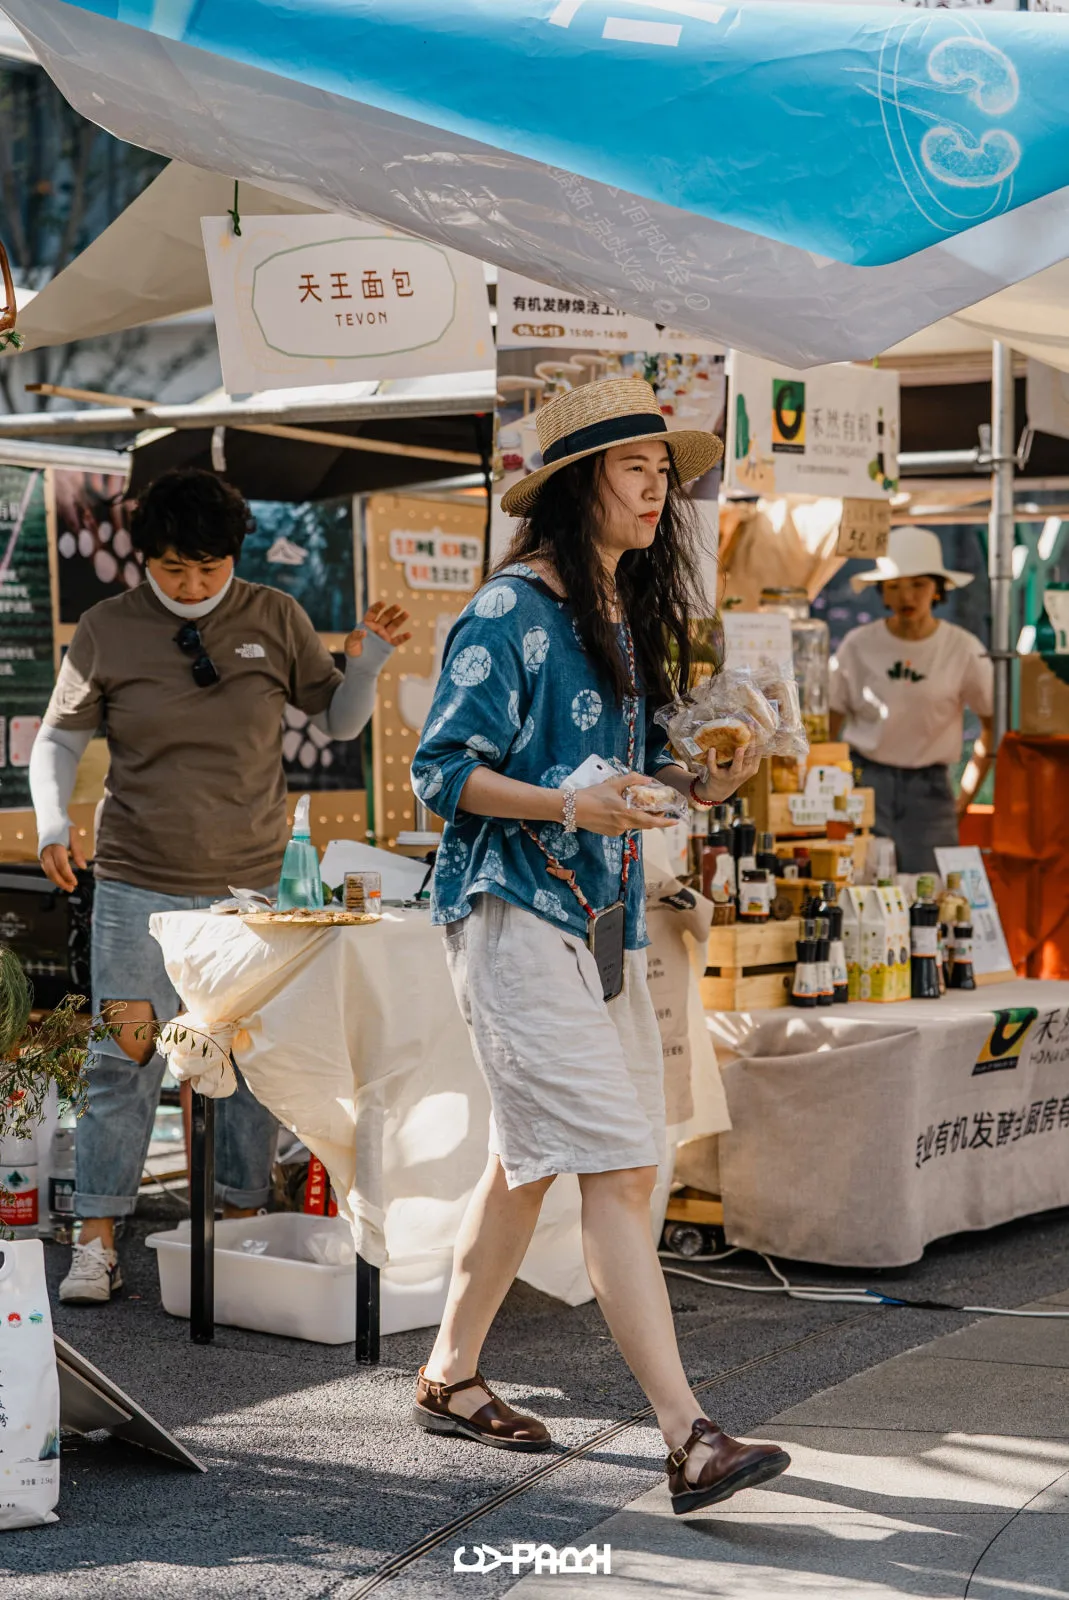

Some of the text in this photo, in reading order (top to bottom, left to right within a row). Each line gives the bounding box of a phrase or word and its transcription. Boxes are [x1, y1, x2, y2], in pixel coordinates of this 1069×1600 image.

[298, 268, 414, 303] 天王面包
[335, 311, 388, 327] TEVON
[309, 1156, 322, 1207] TEVO
